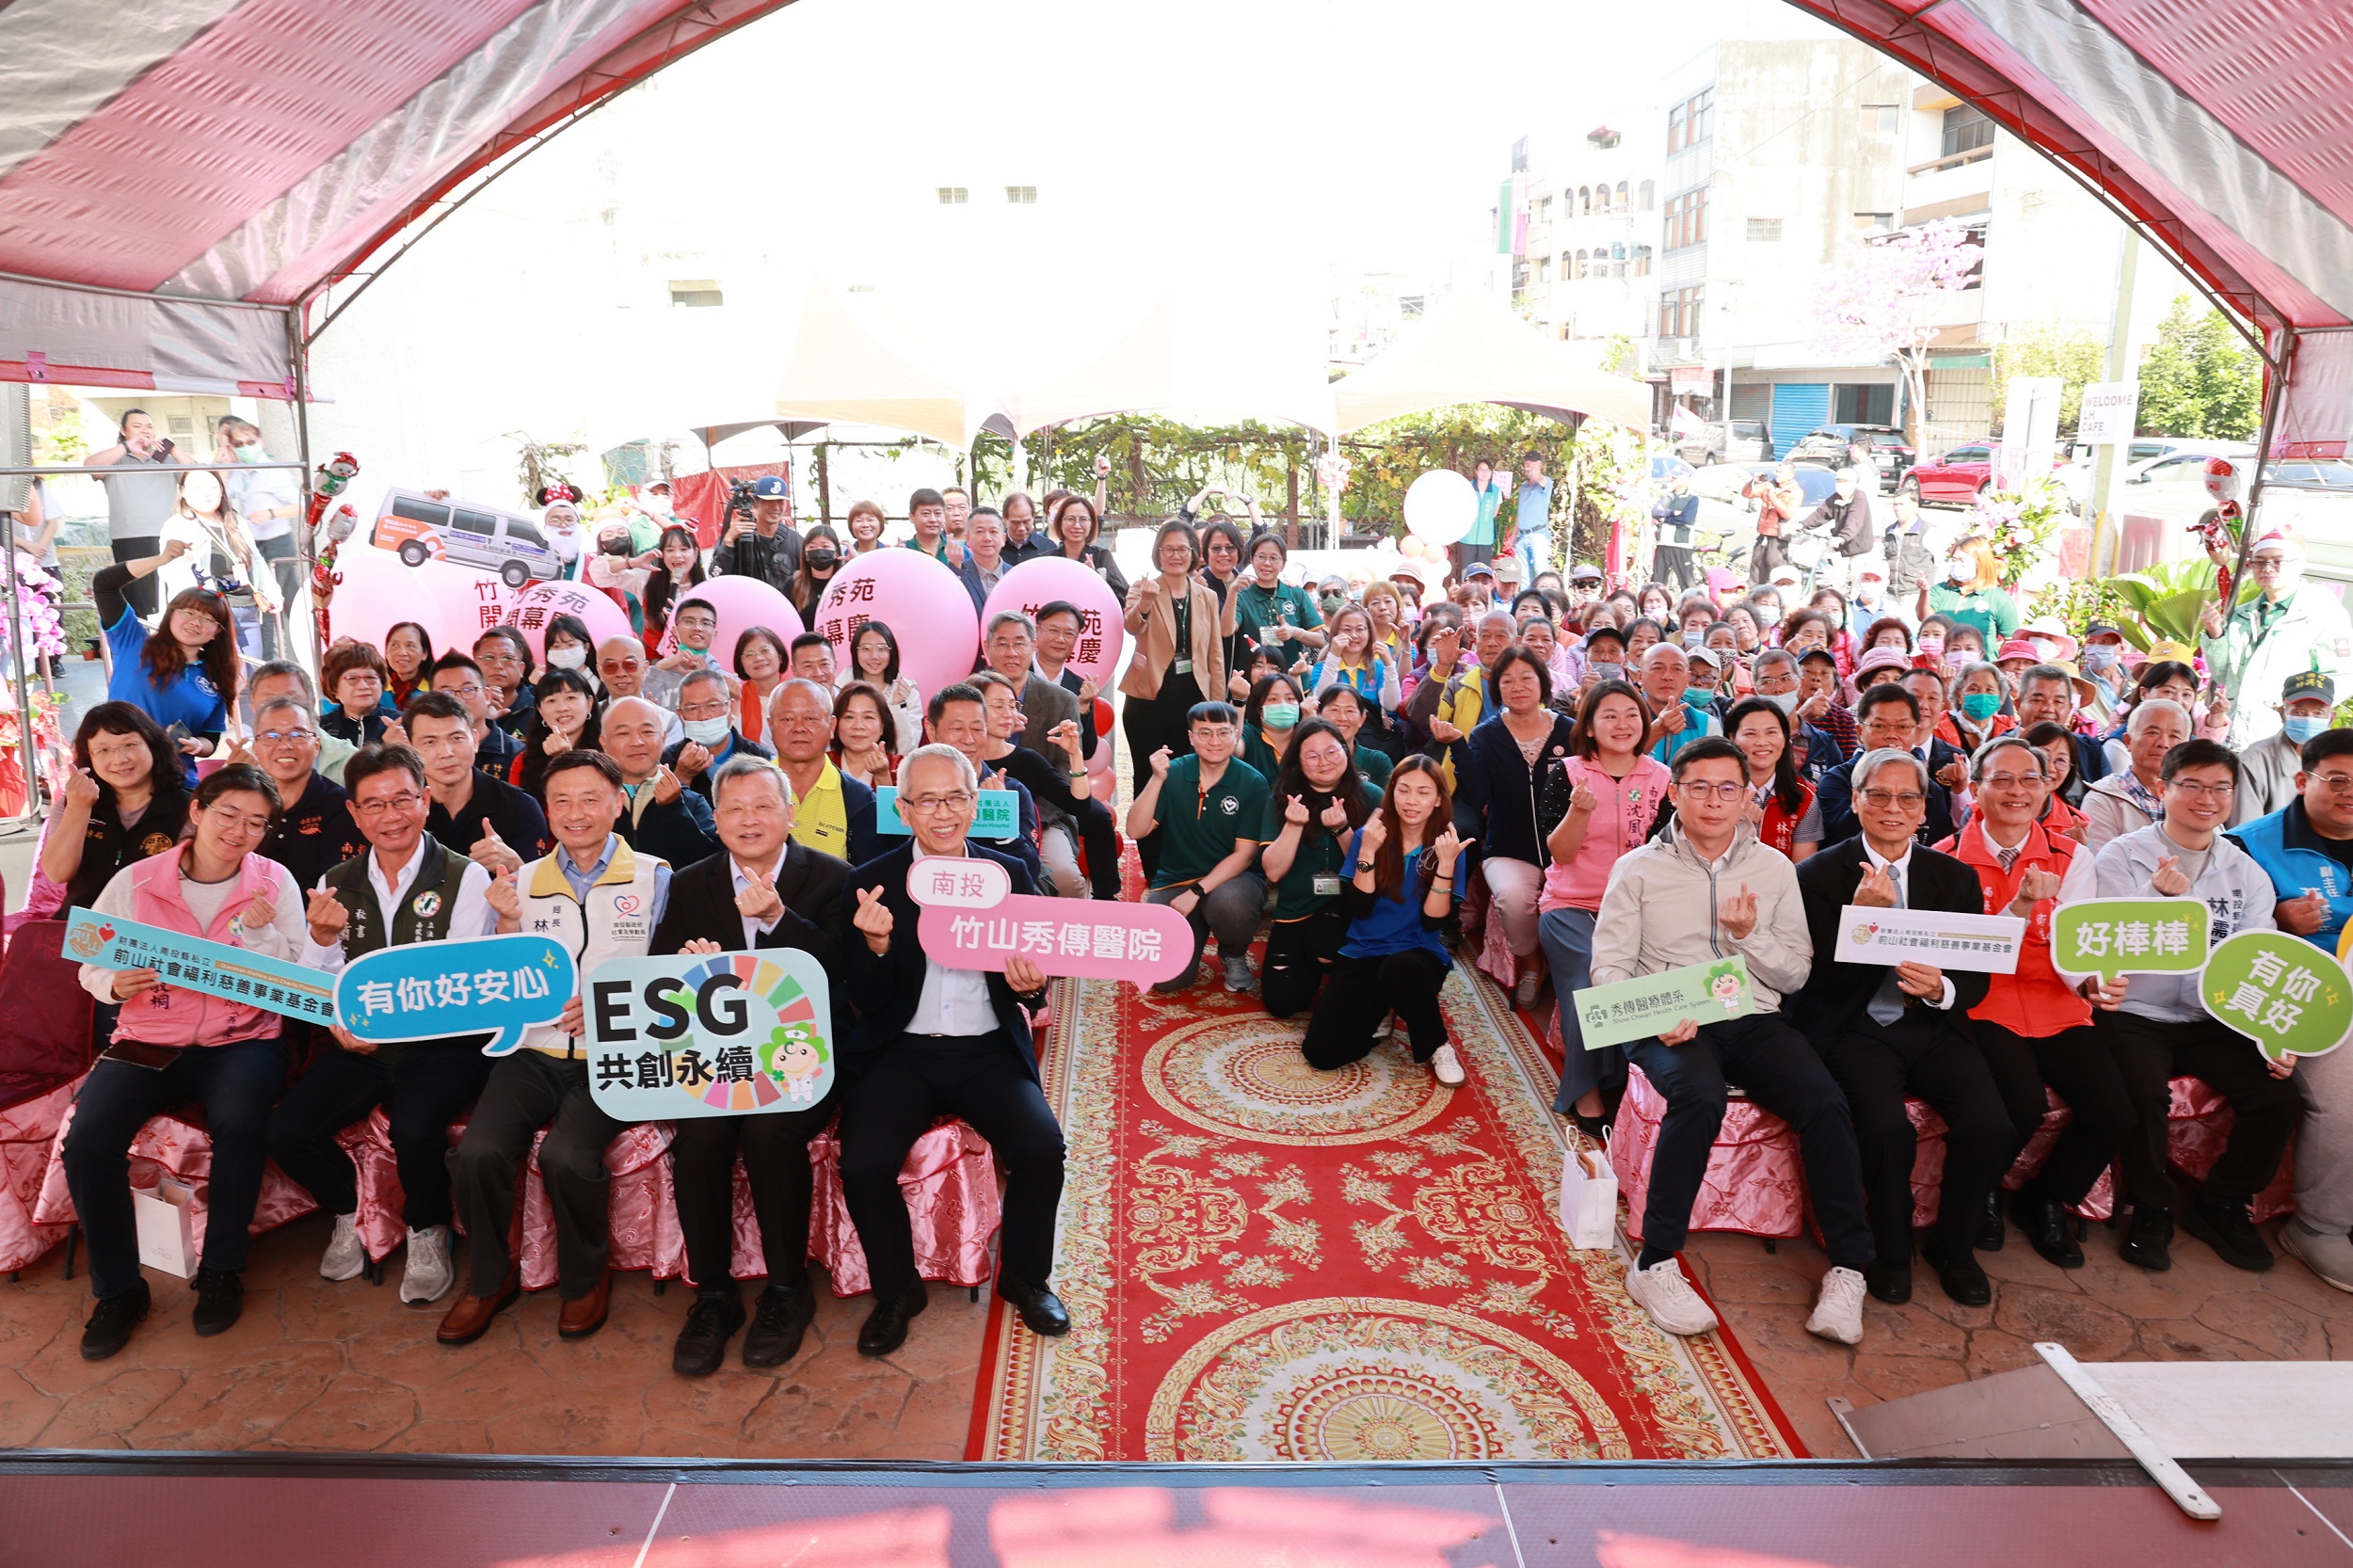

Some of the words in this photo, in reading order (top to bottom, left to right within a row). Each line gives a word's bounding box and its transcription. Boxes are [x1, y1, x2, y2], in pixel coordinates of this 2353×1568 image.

[2083, 409, 2095, 420] LH
[2085, 394, 2134, 408] WELCOME
[2082, 422, 2105, 432] CAFE
[824, 577, 876, 610] 秀苑
[932, 871, 985, 899] 南投
[534, 919, 550, 933] 林
[552, 904, 562, 928] 局長
[2206, 897, 2231, 949] 林儒
[950, 914, 1162, 962] 竹山秀傳醫院
[1878, 936, 2013, 954] 前山社會福利慈善事業基金會
[2074, 919, 2190, 957] 好棒棒
[113, 948, 334, 1018] 前山社會福利慈善事業基金會
[357, 966, 551, 1016] 有你好安心
[2249, 949, 2322, 1003] 有你
[592, 972, 749, 1043] ESG
[1609, 989, 1686, 1018] 秀傳醫療體系
[1612, 1016, 1630, 1025] Show
[1631, 1012, 1652, 1021] Chwan
[1653, 1006, 1673, 1016] Health
[1673, 1003, 1688, 1012] Care
[1689, 999, 1711, 1010] System
[2223, 981, 2304, 1035] 真好
[597, 1046, 755, 1091] 共創永續
